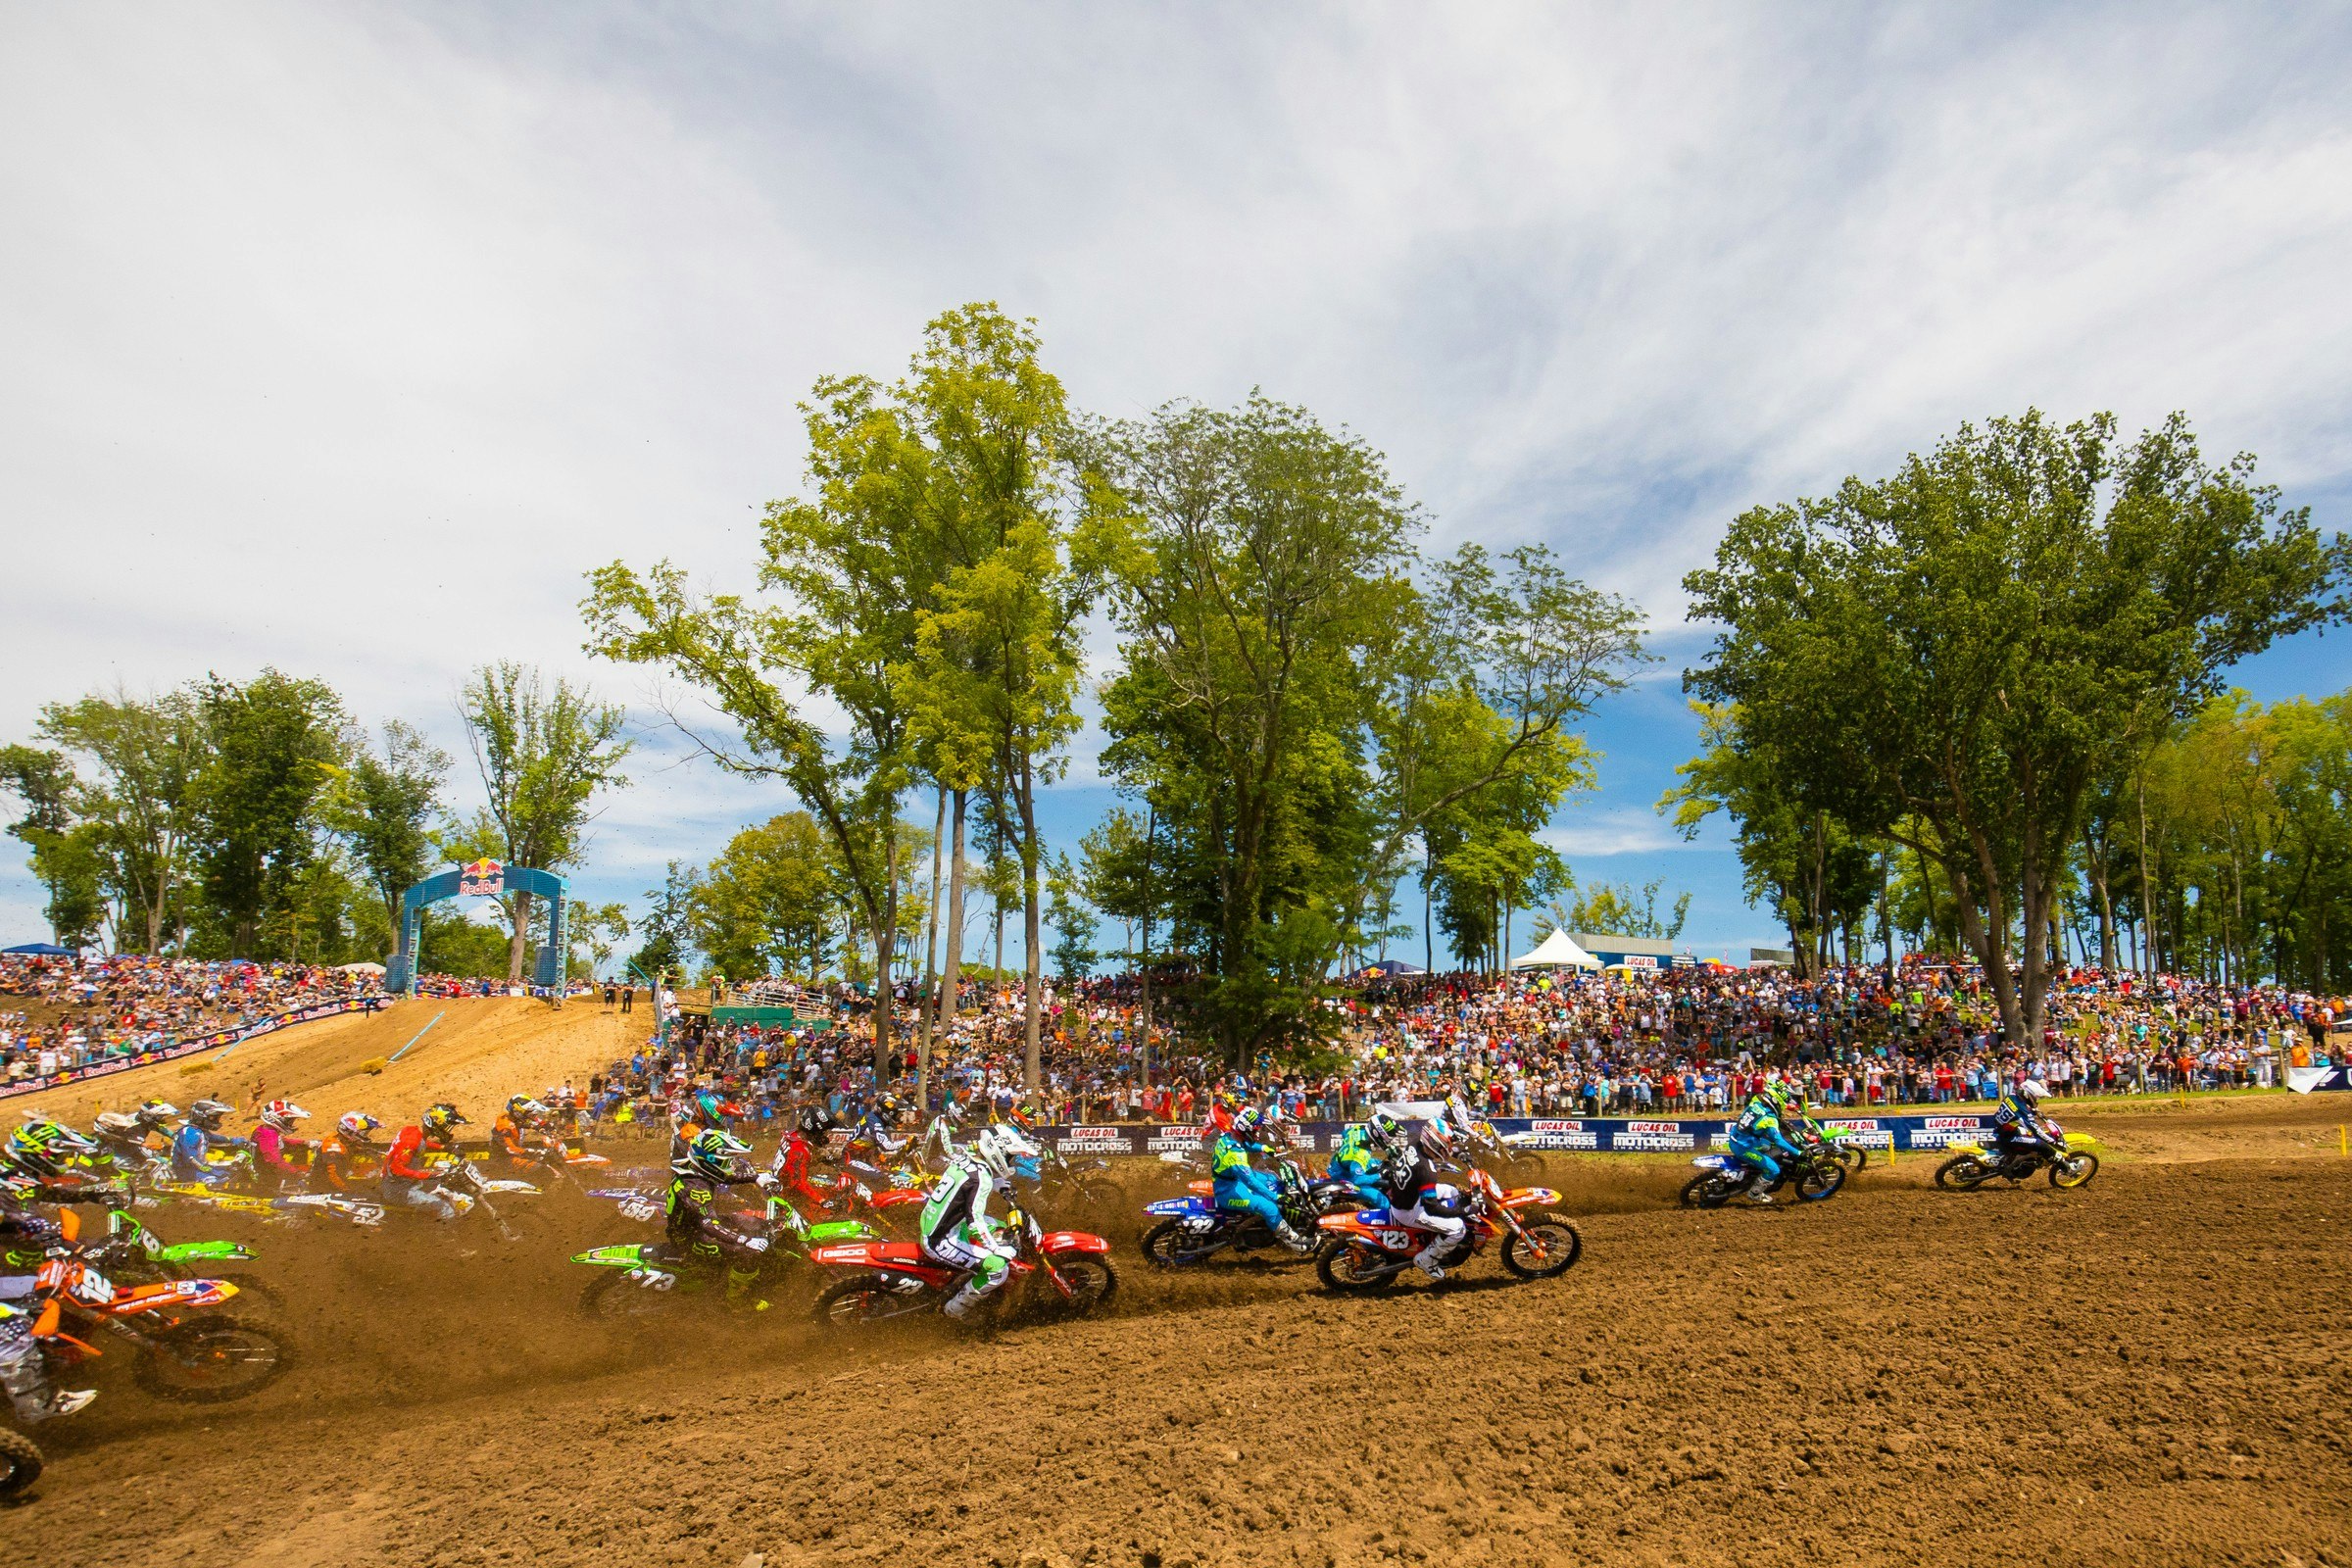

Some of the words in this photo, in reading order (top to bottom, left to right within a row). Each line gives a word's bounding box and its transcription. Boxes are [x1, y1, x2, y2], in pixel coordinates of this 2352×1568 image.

[1627, 956, 1645, 966] LUCAS
[1646, 957, 1656, 966] OIL
[1565, 1122, 1580, 1131] OIL
[1631, 1123, 1660, 1132] LUCAS
[1662, 1123, 1677, 1132] OIL
[1861, 1120, 1876, 1130] OIL
[1929, 1119, 1960, 1128] LUCAS
[1961, 1118, 1978, 1128] OIL
[1073, 1127, 1101, 1137] LUCAS
[1102, 1127, 1116, 1137] OIL
[1163, 1127, 1192, 1136] LUCAS
[1519, 1135, 1596, 1146] OTOCROSS
[1613, 1136, 1694, 1147] MOTOCROSS
[1911, 1133, 1997, 1144] MOTOCROSS
[1056, 1141, 1133, 1152] MOTOCROSS
[1147, 1140, 1202, 1151] MOTOCR
[1190, 1219, 1214, 1235] 32
[1382, 1230, 1409, 1250] 123
[823, 1249, 867, 1258] GEICO
[893, 1256, 917, 1265] HONDA
[640, 1269, 676, 1292] 73
[890, 1277, 925, 1295] 23
